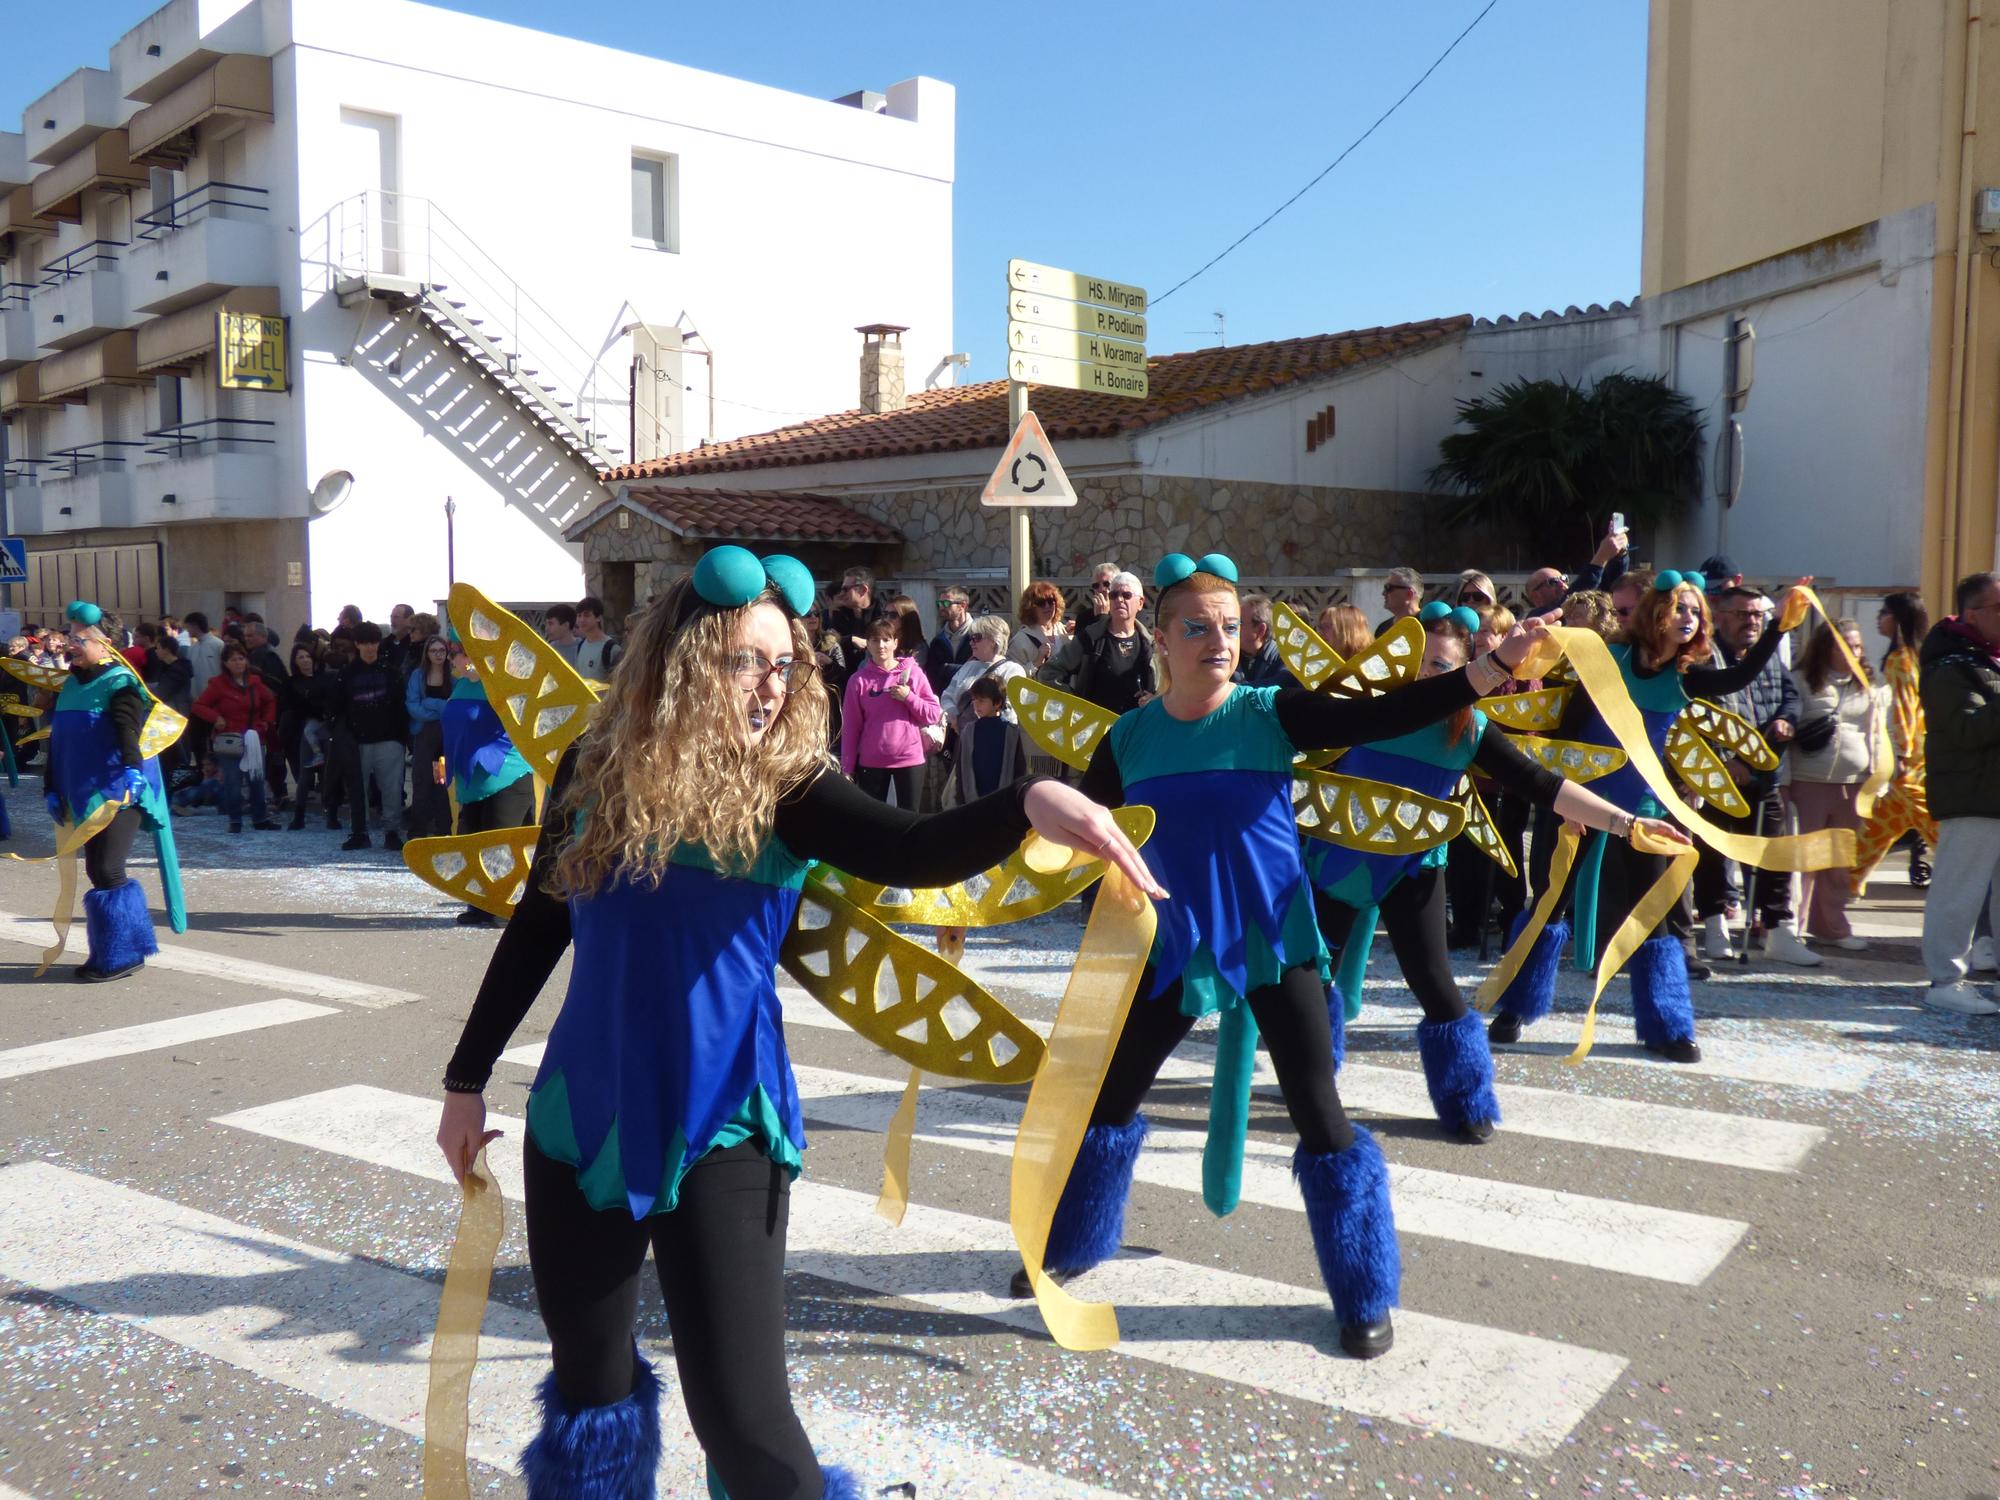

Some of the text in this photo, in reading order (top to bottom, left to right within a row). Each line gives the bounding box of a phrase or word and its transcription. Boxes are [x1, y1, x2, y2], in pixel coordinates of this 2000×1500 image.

[1088, 281, 1144, 308] HS. Miryam
[1097, 313, 1144, 336] P. Podium
[225, 336, 282, 372] HOTEL
[1090, 340, 1143, 364] H. Voramar
[1094, 369, 1144, 392] H. Bonaire
